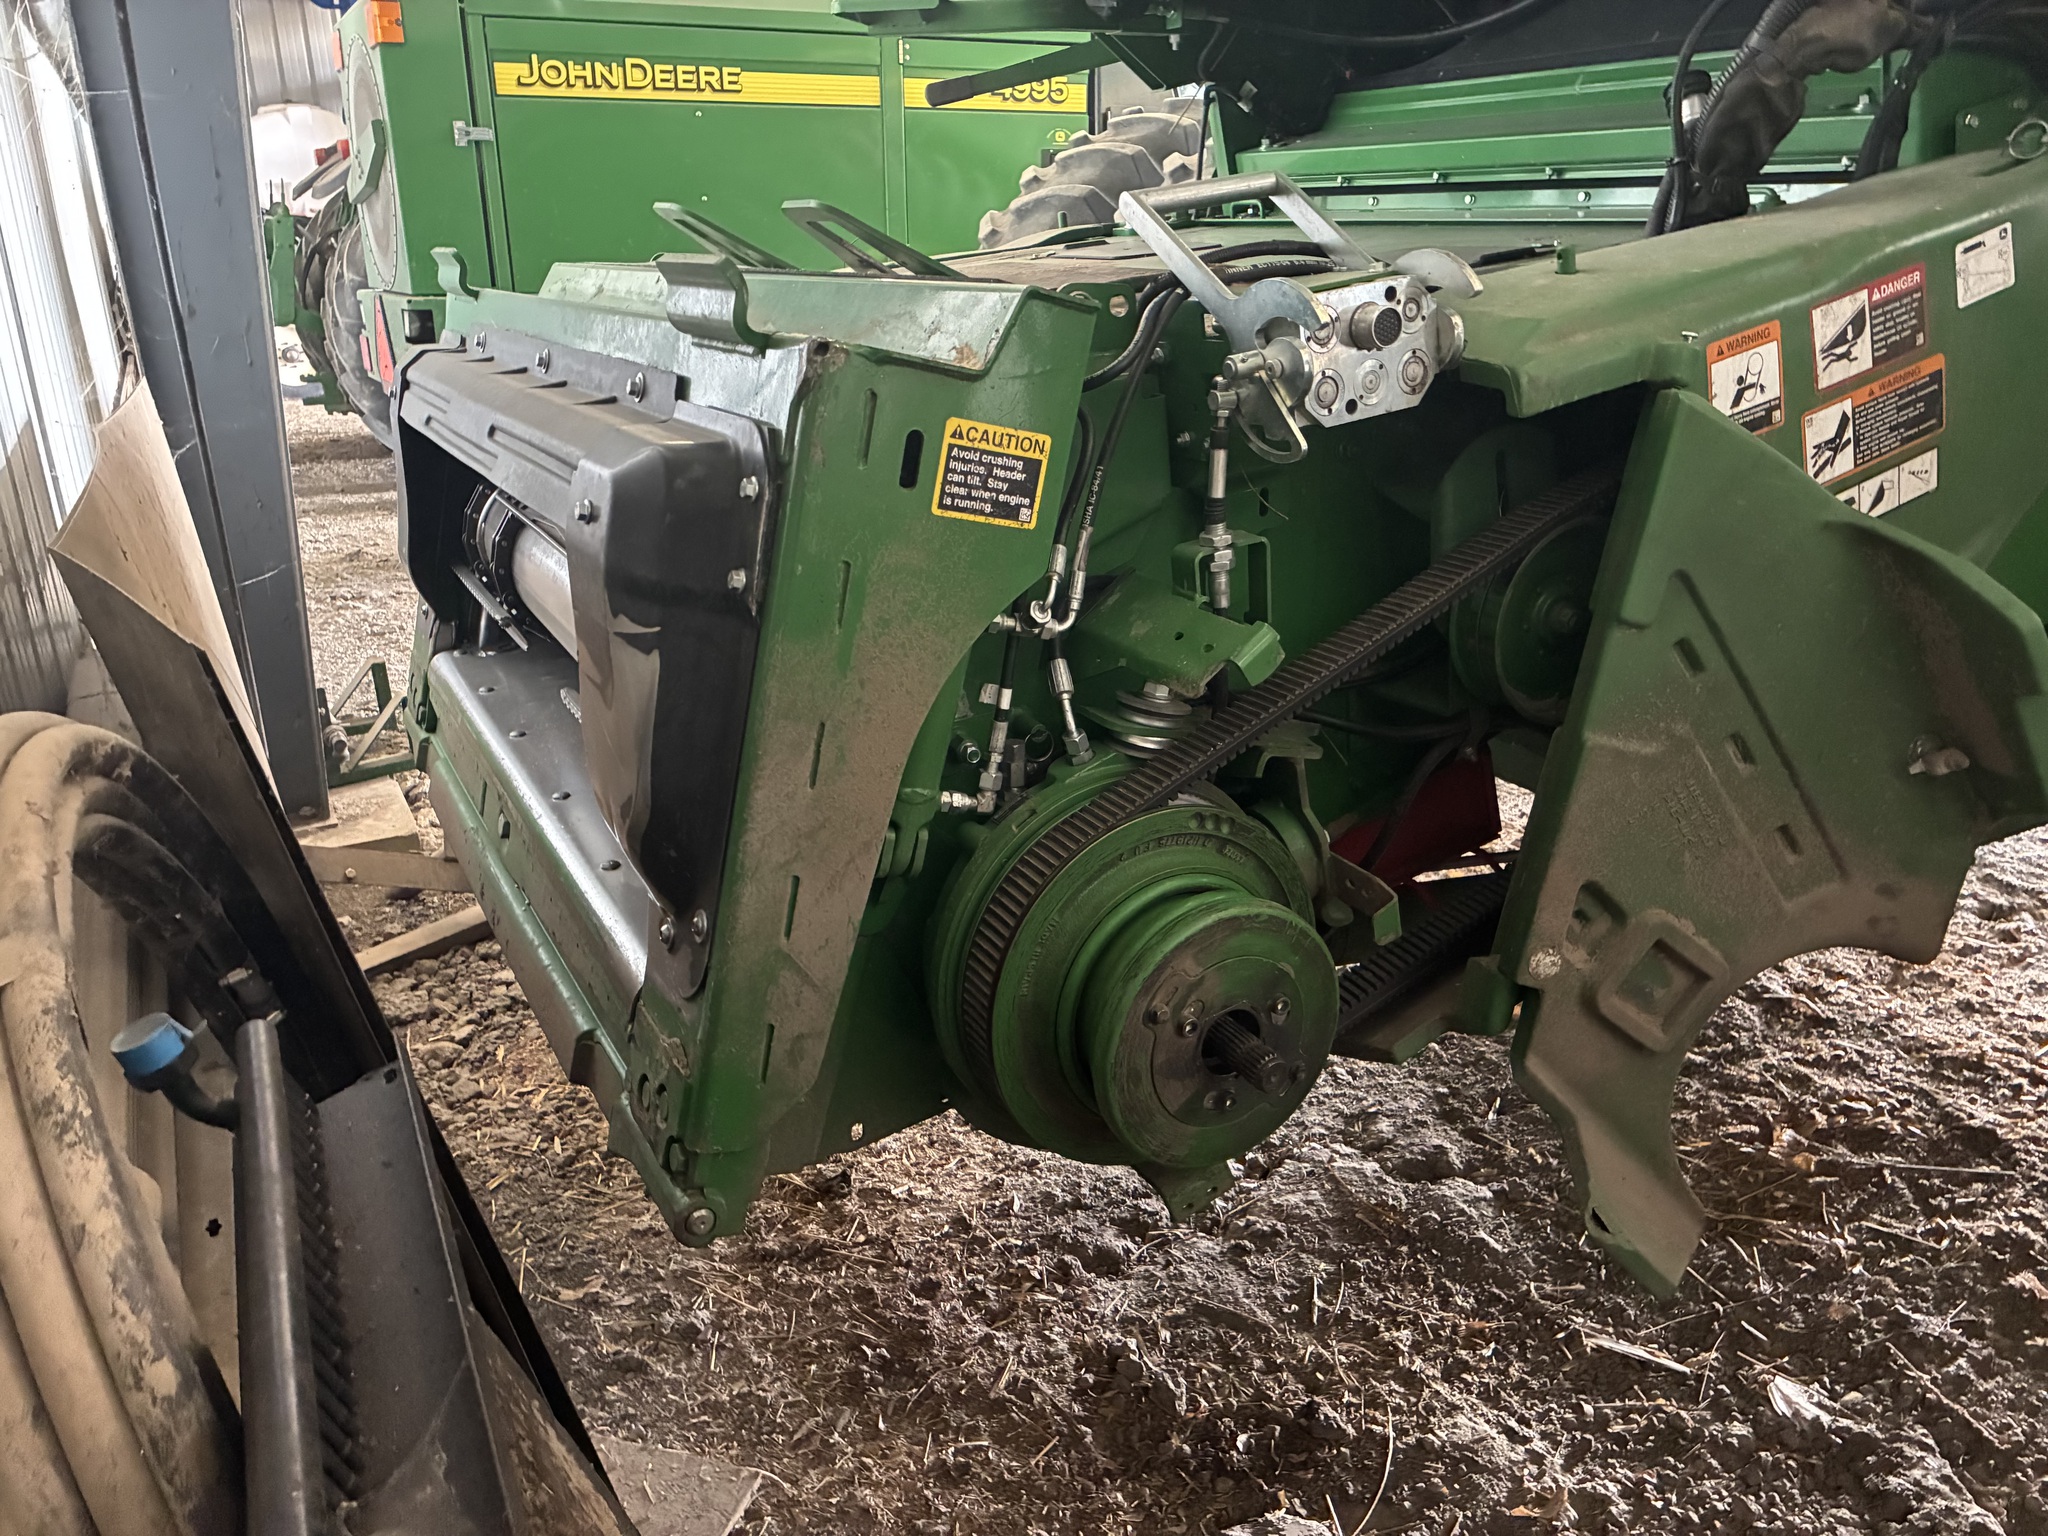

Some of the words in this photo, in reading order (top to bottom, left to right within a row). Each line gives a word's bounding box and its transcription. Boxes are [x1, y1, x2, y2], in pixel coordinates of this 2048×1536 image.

[1880, 271, 1920, 298] DANGER
[1725, 327, 1771, 353] WARNING
[1878, 367, 1921, 391] WARNING
[966, 426, 1046, 455] CAUTION
[951, 447, 980, 462] Avoid
[981, 453, 1024, 470] crushing
[949, 459, 987, 476] injuries.
[992, 466, 1027, 482] Header
[947, 473, 966, 484] can
[967, 475, 982, 487] tilt.
[987, 477, 1009, 492] Stay
[943, 496, 952, 505] is
[953, 499, 994, 513] running.
[945, 484, 969, 496] clear
[971, 487, 996, 501] when
[998, 493, 1030, 507] engine
